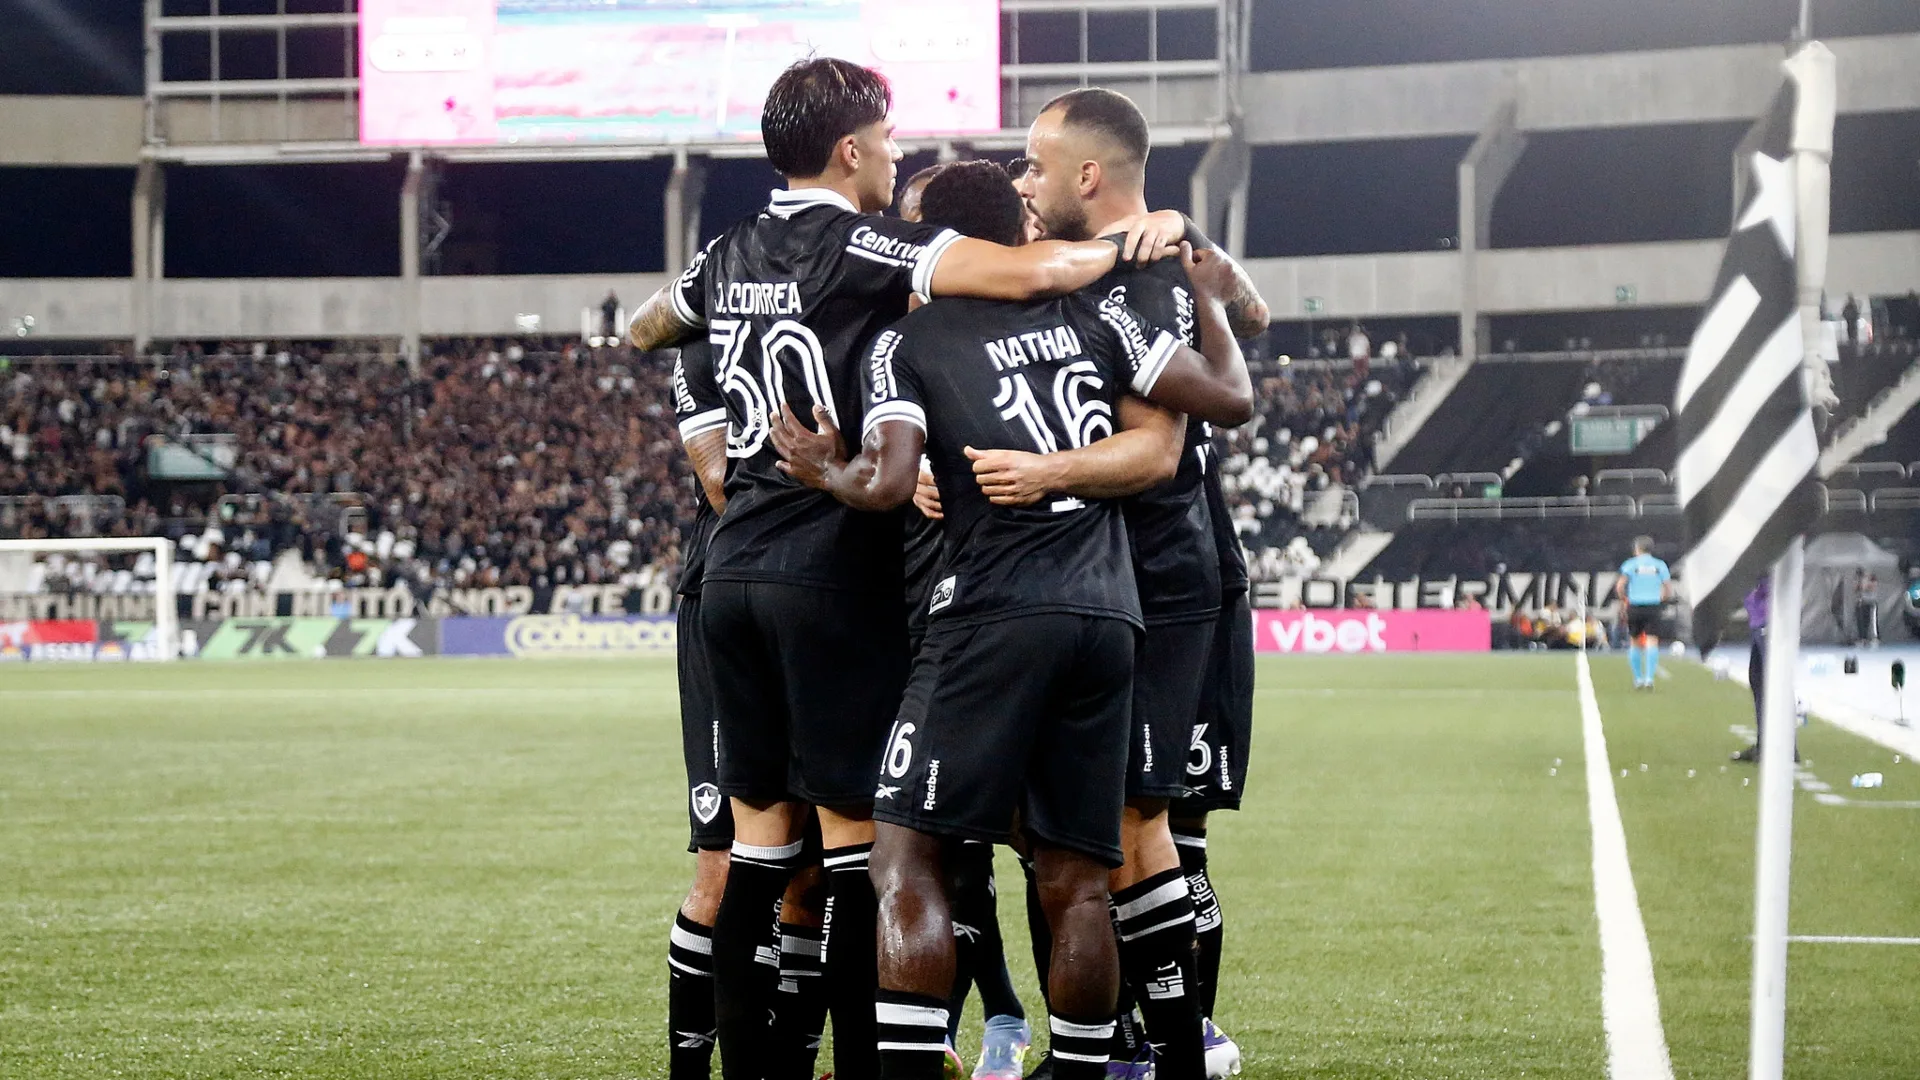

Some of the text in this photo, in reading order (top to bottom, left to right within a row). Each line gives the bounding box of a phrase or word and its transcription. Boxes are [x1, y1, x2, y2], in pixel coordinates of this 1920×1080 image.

[715, 281, 802, 315] J.CORREA
[711, 320, 840, 458] 30
[993, 361, 1112, 455] 16
[351, 618, 424, 657] 7K
[1269, 612, 1387, 652] vbet
[1143, 724, 1153, 772] Reebok
[1219, 746, 1232, 791] Reebok
[923, 759, 940, 811] Reebok
